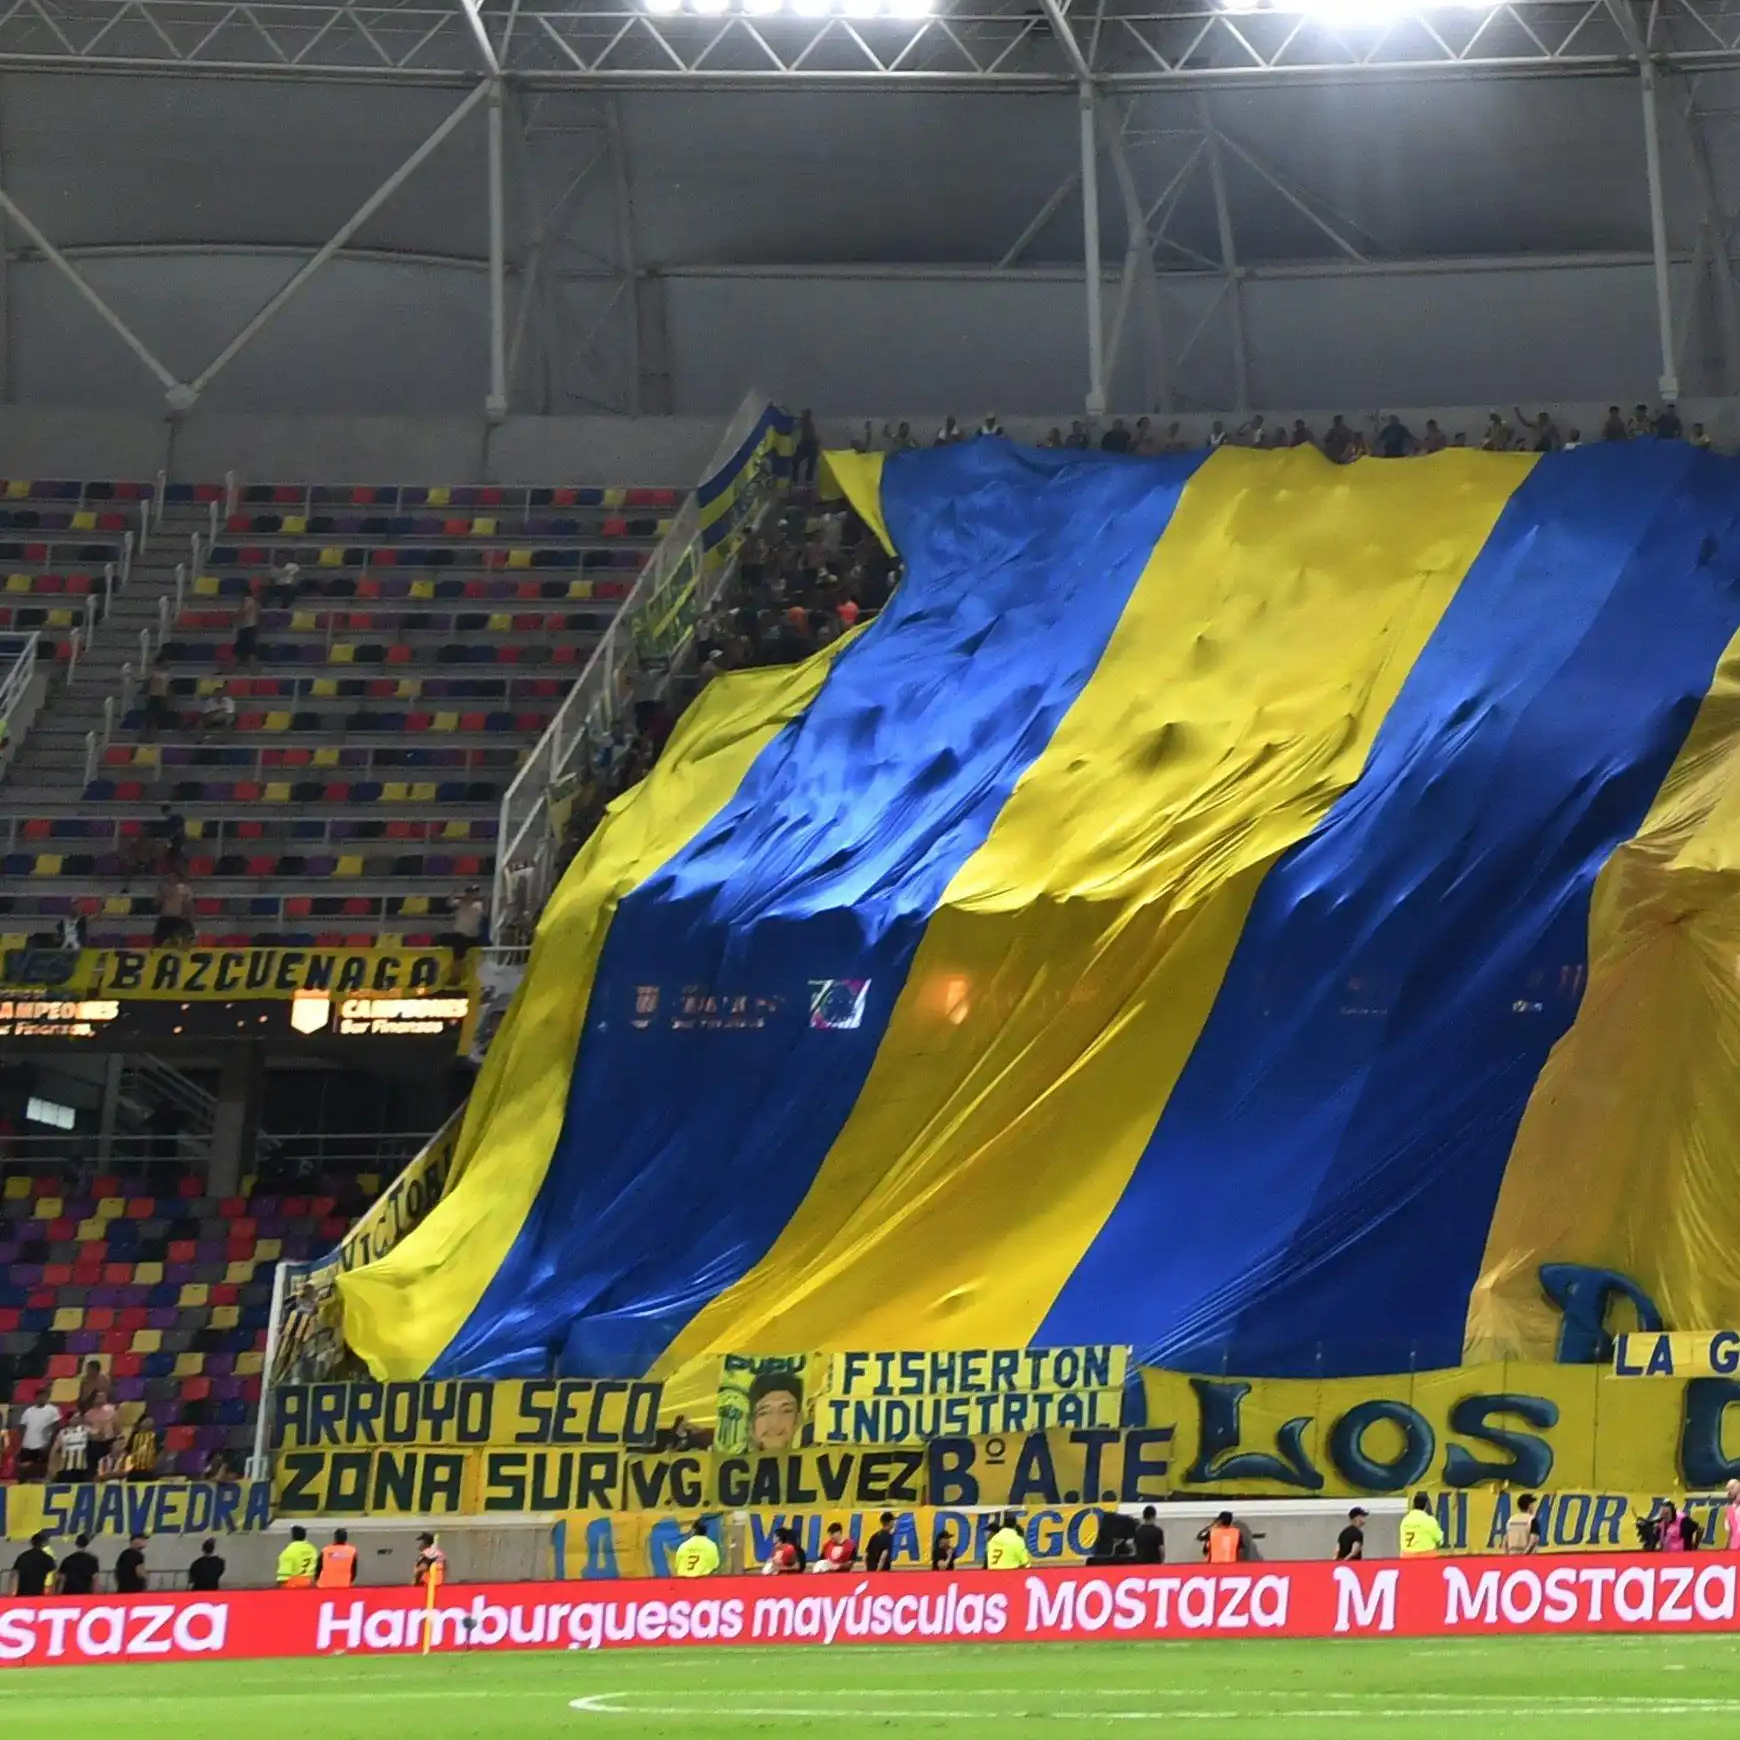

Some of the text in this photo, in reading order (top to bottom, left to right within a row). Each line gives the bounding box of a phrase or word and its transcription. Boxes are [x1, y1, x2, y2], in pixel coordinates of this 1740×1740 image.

[843, 1345, 1111, 1395] FISHERTON
[1616, 1333, 1675, 1377] LA
[270, 1380, 664, 1448] ARROYO SECO
[827, 1391, 1111, 1444] INDUSTRIAL
[278, 1452, 622, 1512] ZONA SUR
[716, 1449, 925, 1508] GALVEZ
[42, 1479, 271, 1537] SAAVEDRA
[932, 1508, 1108, 1561] DIGO
[316, 1580, 1008, 1650] Hamburguesas mayúsculas
